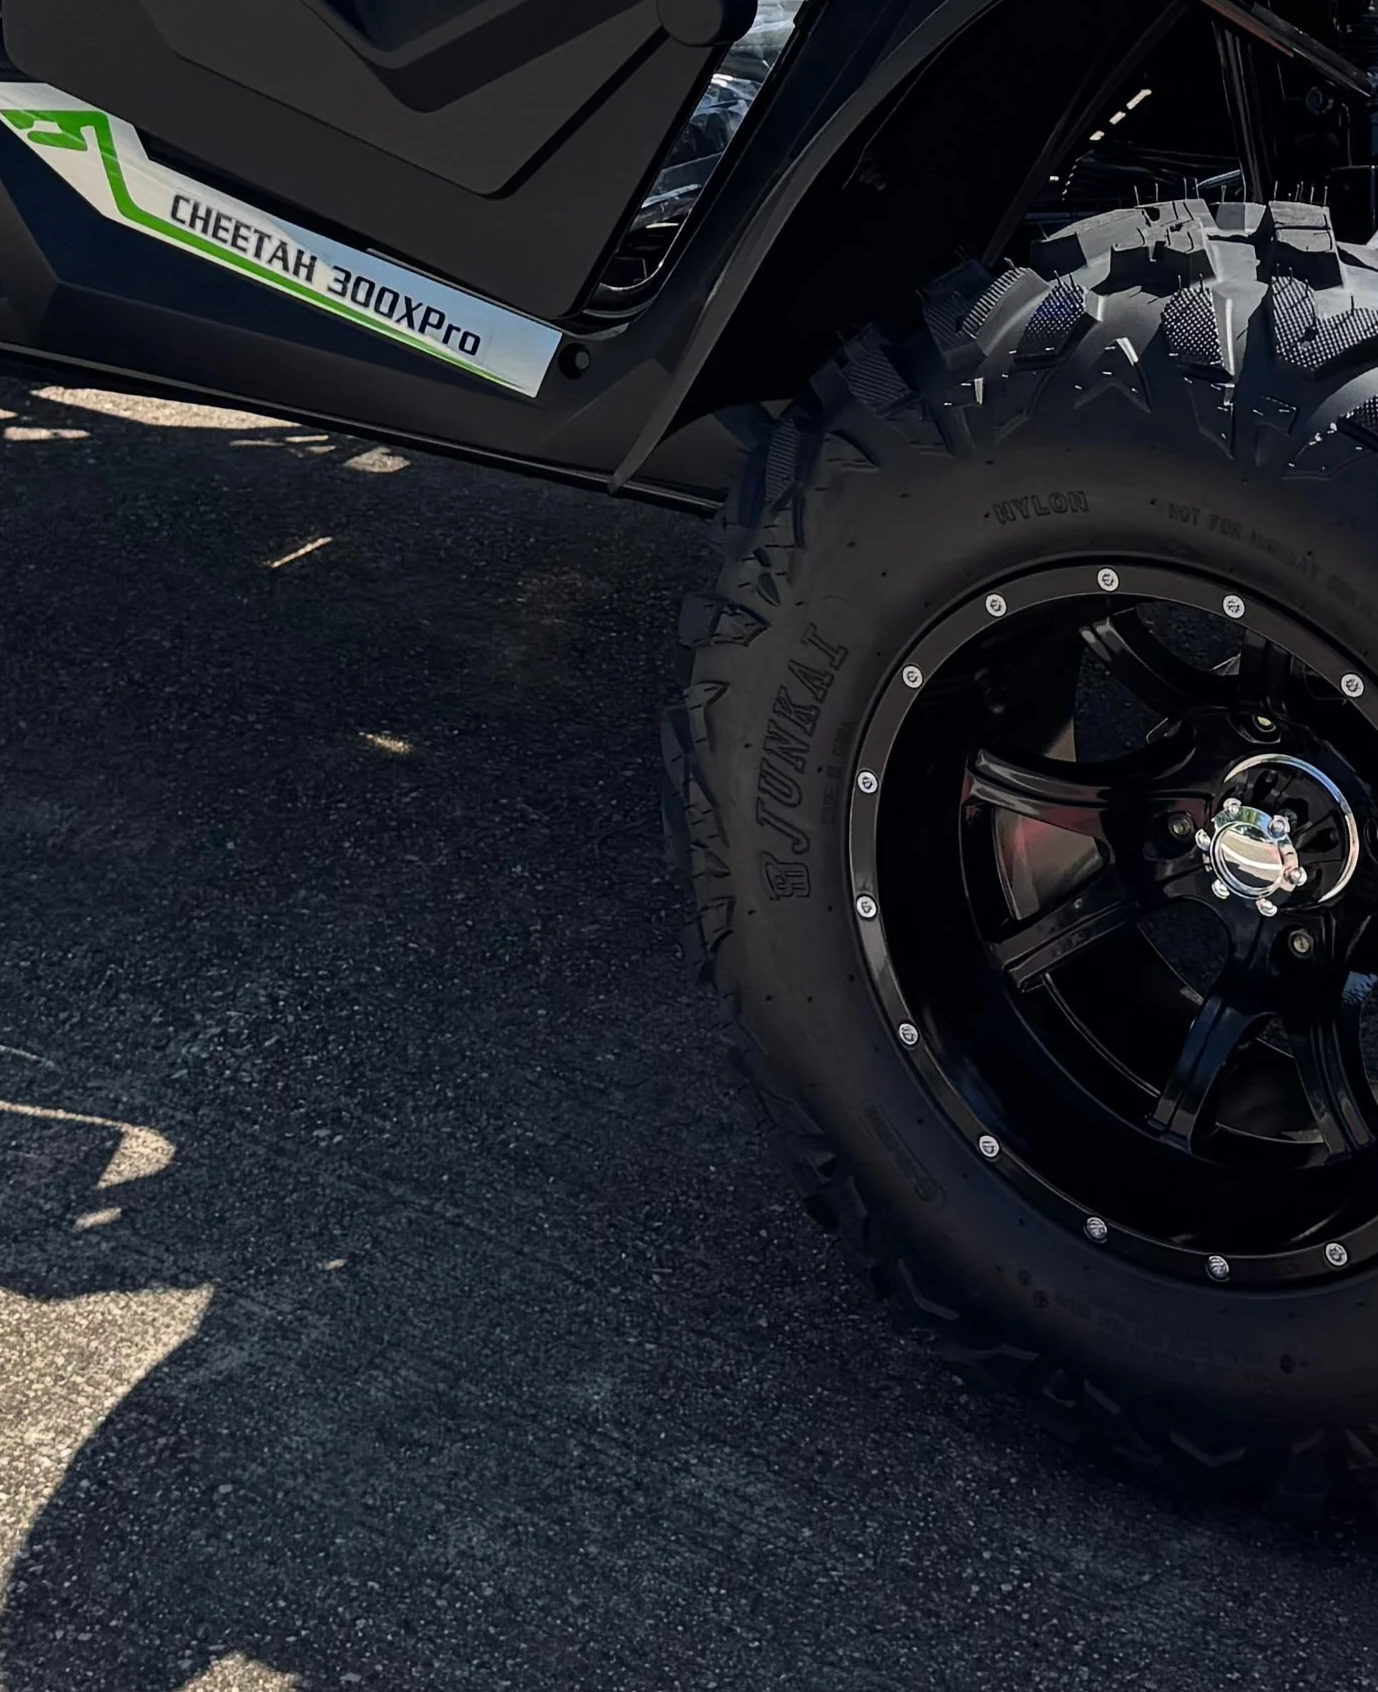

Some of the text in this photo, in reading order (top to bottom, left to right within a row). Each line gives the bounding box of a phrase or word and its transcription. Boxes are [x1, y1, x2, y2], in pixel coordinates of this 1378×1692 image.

[169, 194, 482, 357] CHEETAH 300XPro
[992, 490, 1091, 525] NYLON
[755, 622, 849, 855] JUNKAI
